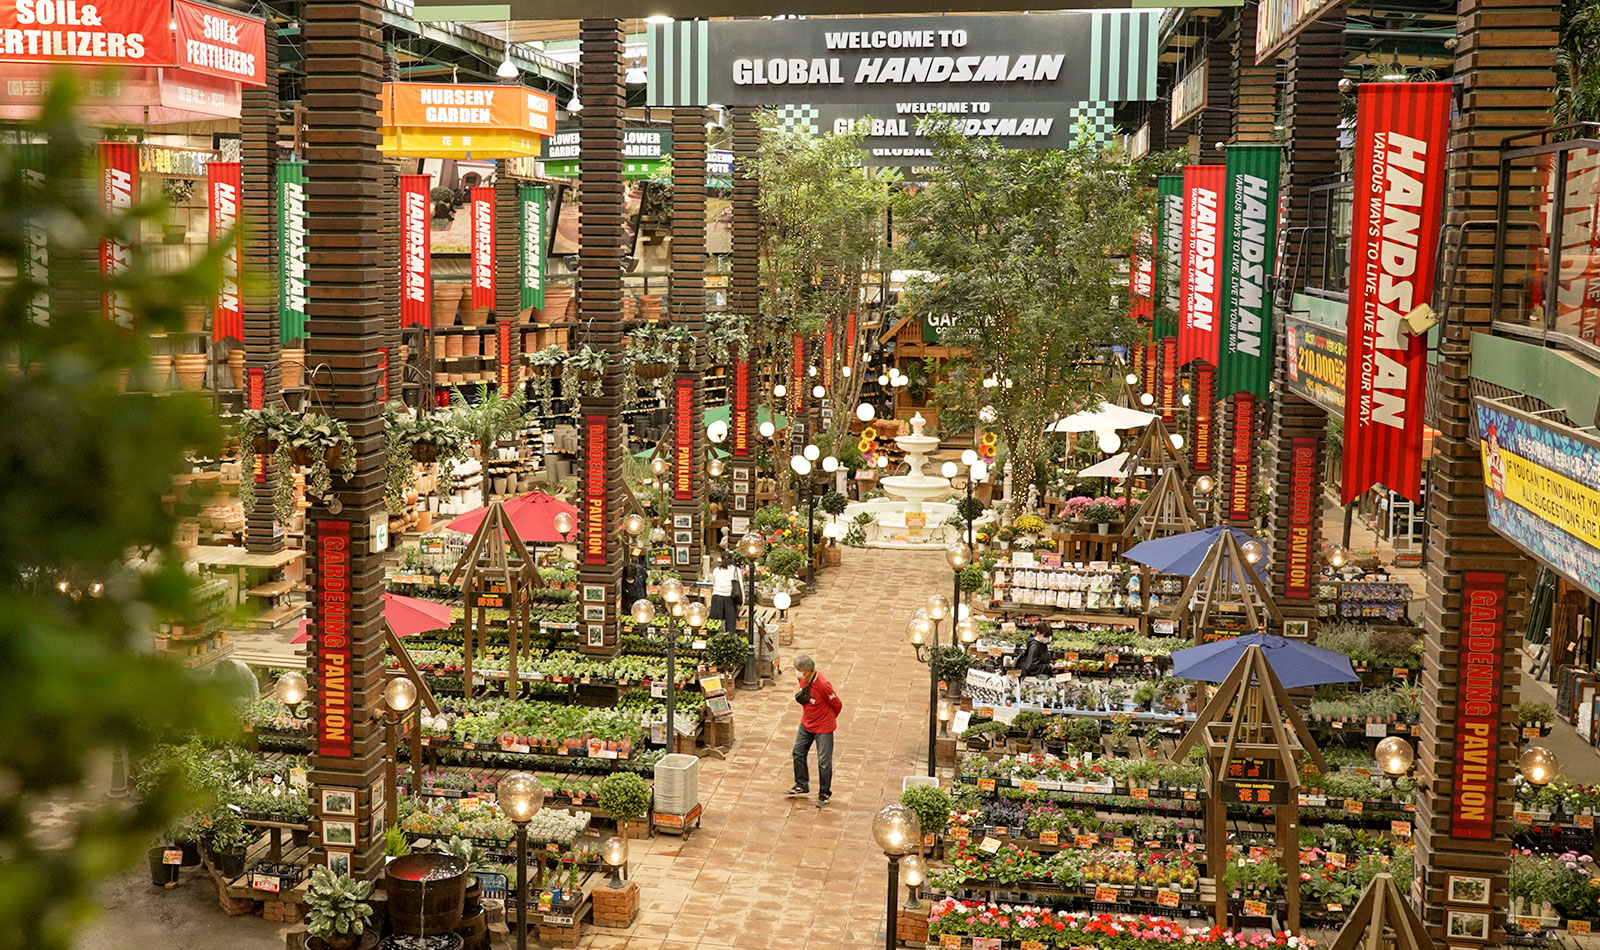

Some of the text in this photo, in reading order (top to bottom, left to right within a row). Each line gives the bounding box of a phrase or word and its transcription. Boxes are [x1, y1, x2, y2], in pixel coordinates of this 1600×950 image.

[15, 0, 102, 26] SOIL&
[203, 14, 239, 45] SOIL&
[187, 38, 255, 77] FERTILIZERS
[825, 29, 968, 50] WELCOME TO
[732, 54, 1066, 85] GLOBAL HANDSMAN
[421, 89, 495, 106] NURSERY
[425, 107, 491, 124] GARDEN
[896, 102, 990, 114] WELCOME TO
[621, 144, 661, 156] ARDEN
[623, 132, 661, 144] LOWER
[1190, 187, 1198, 218] VARIOUS
[289, 182, 306, 313] HANDSMAN
[410, 191, 425, 303] HANDSMAN
[479, 200, 491, 290] HANDSMAN
[528, 200, 540, 290] HANDSMAN
[1189, 239, 1196, 249] TO
[1193, 188, 1217, 332] HANDSMAN
[1228, 174, 1243, 354] VARIOUS WAYS TO LIVE, LIVE IT YOUR WAY.
[1237, 173, 1268, 358] HANDSMAN
[1188, 283, 1194, 292] IT
[1358, 132, 1386, 429] VARIOUS WAYS TO LIVE, LIVE IT YOUR WAY.
[1372, 131, 1427, 430] HANDSMAN
[736, 411, 746, 449] PAVILION
[1197, 424, 1209, 463] PAVILION
[678, 446, 690, 492] PAVILION
[1233, 401, 1251, 512] GARDENING PAVILION
[589, 424, 604, 554] GARDENING PAVILION
[1513, 461, 1526, 480] YOU
[1546, 478, 1564, 499] FIND
[1564, 486, 1586, 512] WHAT
[1290, 447, 1313, 588] GARDENING PAVILION
[1522, 485, 1534, 505] ALL
[1534, 492, 1581, 531] SUGGESTIONS
[1582, 517, 1597, 540] ARE
[323, 536, 345, 741] GARDENING PAVILION
[1460, 589, 1497, 821] GARDENING PAVILION
[1239, 789, 1271, 802] 花苗
